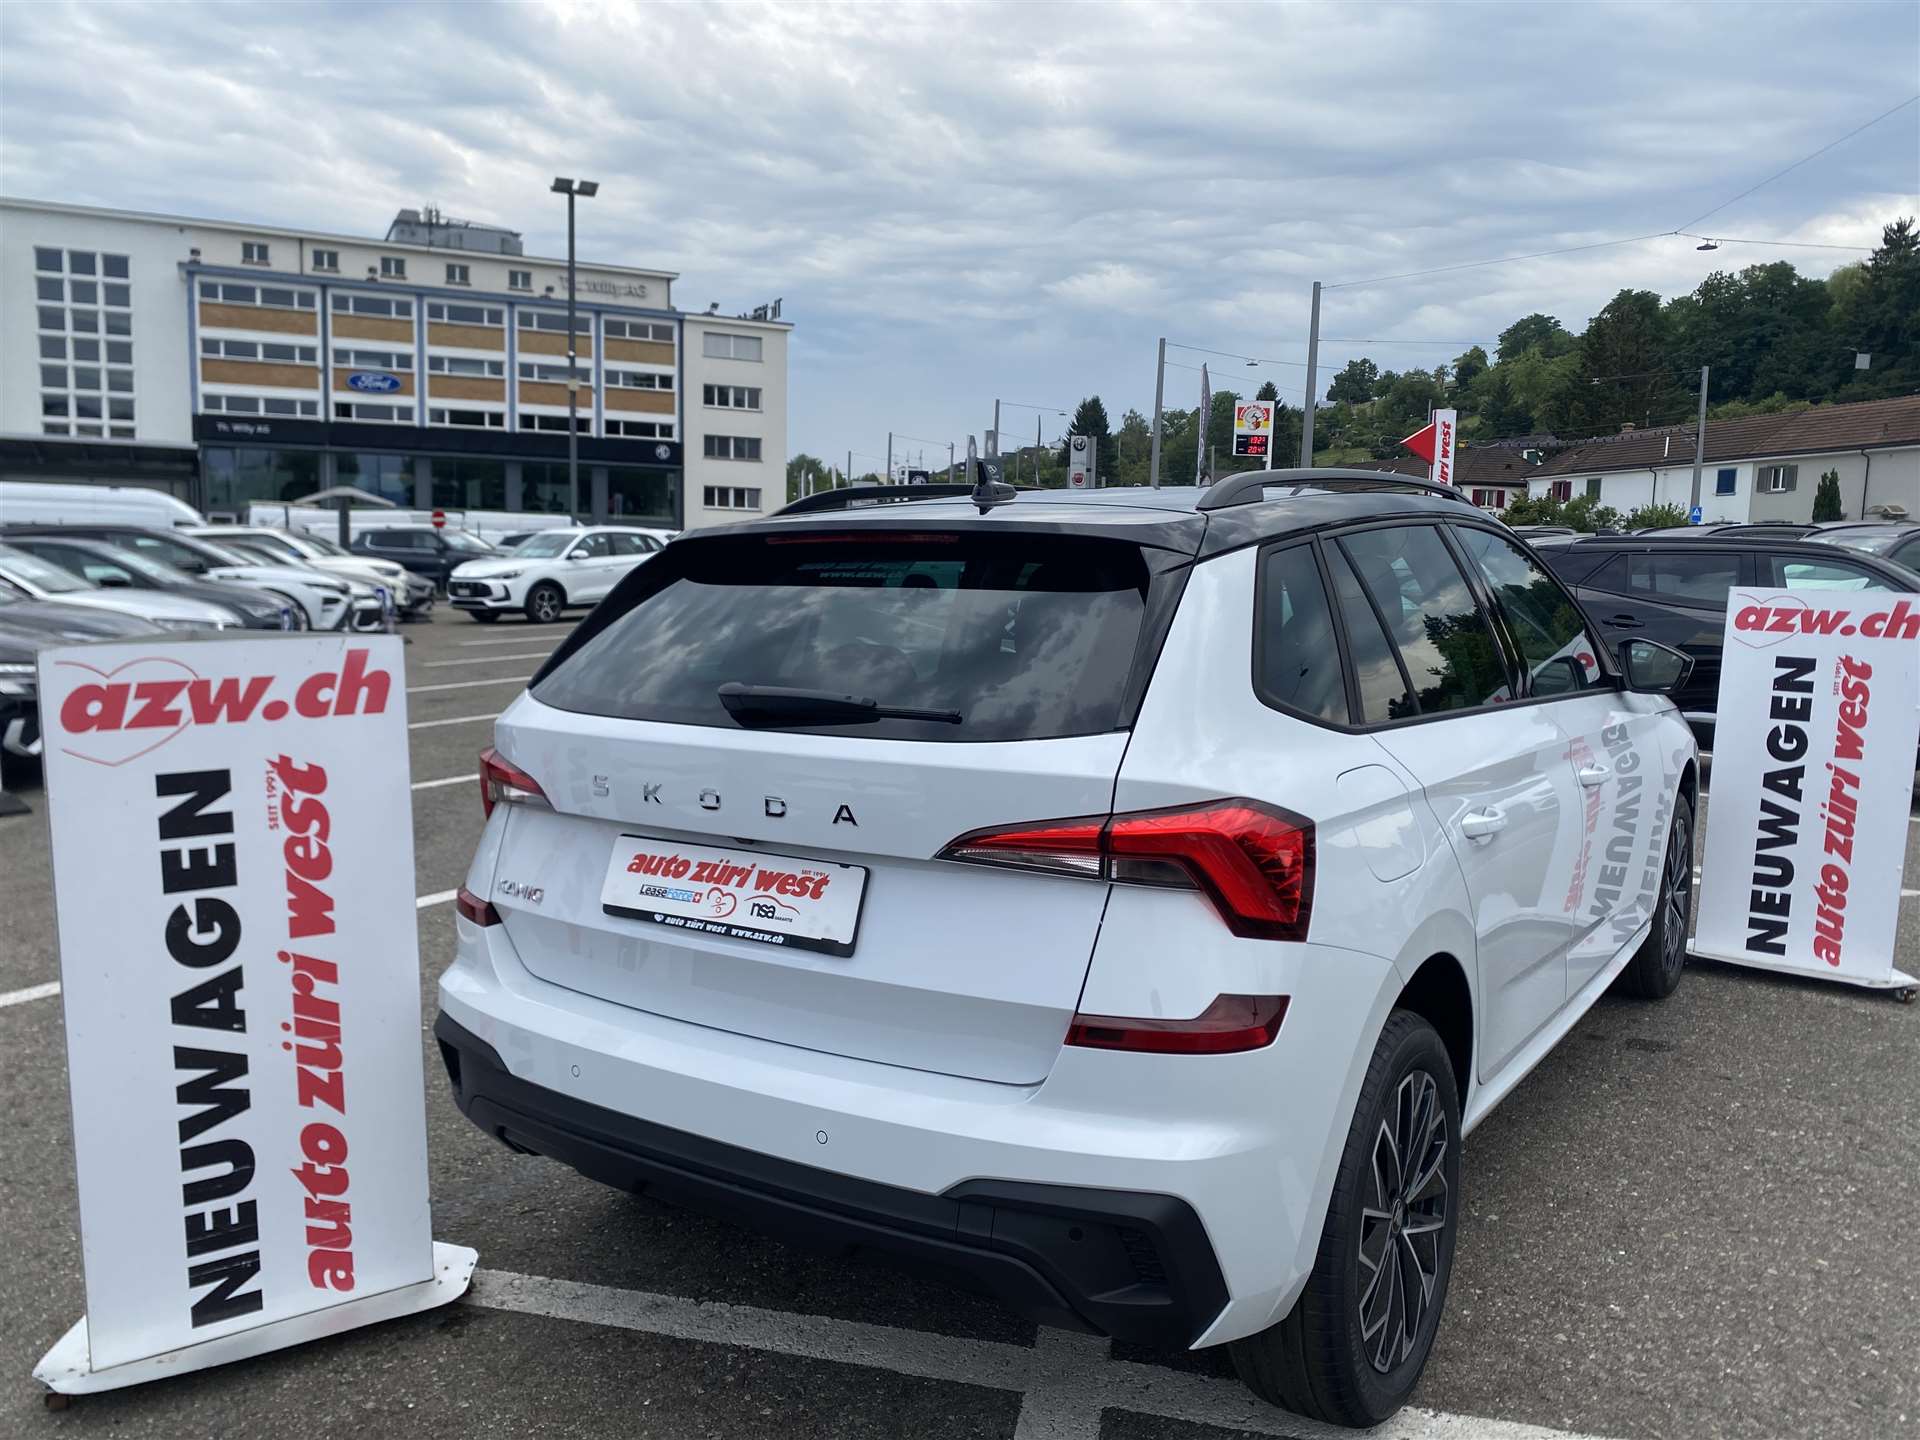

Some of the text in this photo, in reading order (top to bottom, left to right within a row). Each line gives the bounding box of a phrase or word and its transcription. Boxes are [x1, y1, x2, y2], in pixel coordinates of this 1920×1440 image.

[354, 374, 395, 391] Ford
[1440, 421, 1453, 460] west
[1734, 600, 1920, 641] azw.ch
[60, 648, 391, 733] azw.ch
[1832, 660, 1844, 697] SEIT 1991
[265, 768, 280, 831] SEIT 1991
[1745, 655, 1818, 957] NEUWAGEN
[1813, 654, 1874, 968] auto züri west
[626, 852, 831, 900] auto züri west
[800, 868, 813, 877] SEIT
[664, 916, 685, 927] auto
[685, 919, 704, 930] züri
[705, 922, 727, 934] west
[750, 902, 775, 920] nsa
[266, 753, 356, 1292] auto züri west
[154, 768, 263, 1329] NEUWAGEN
